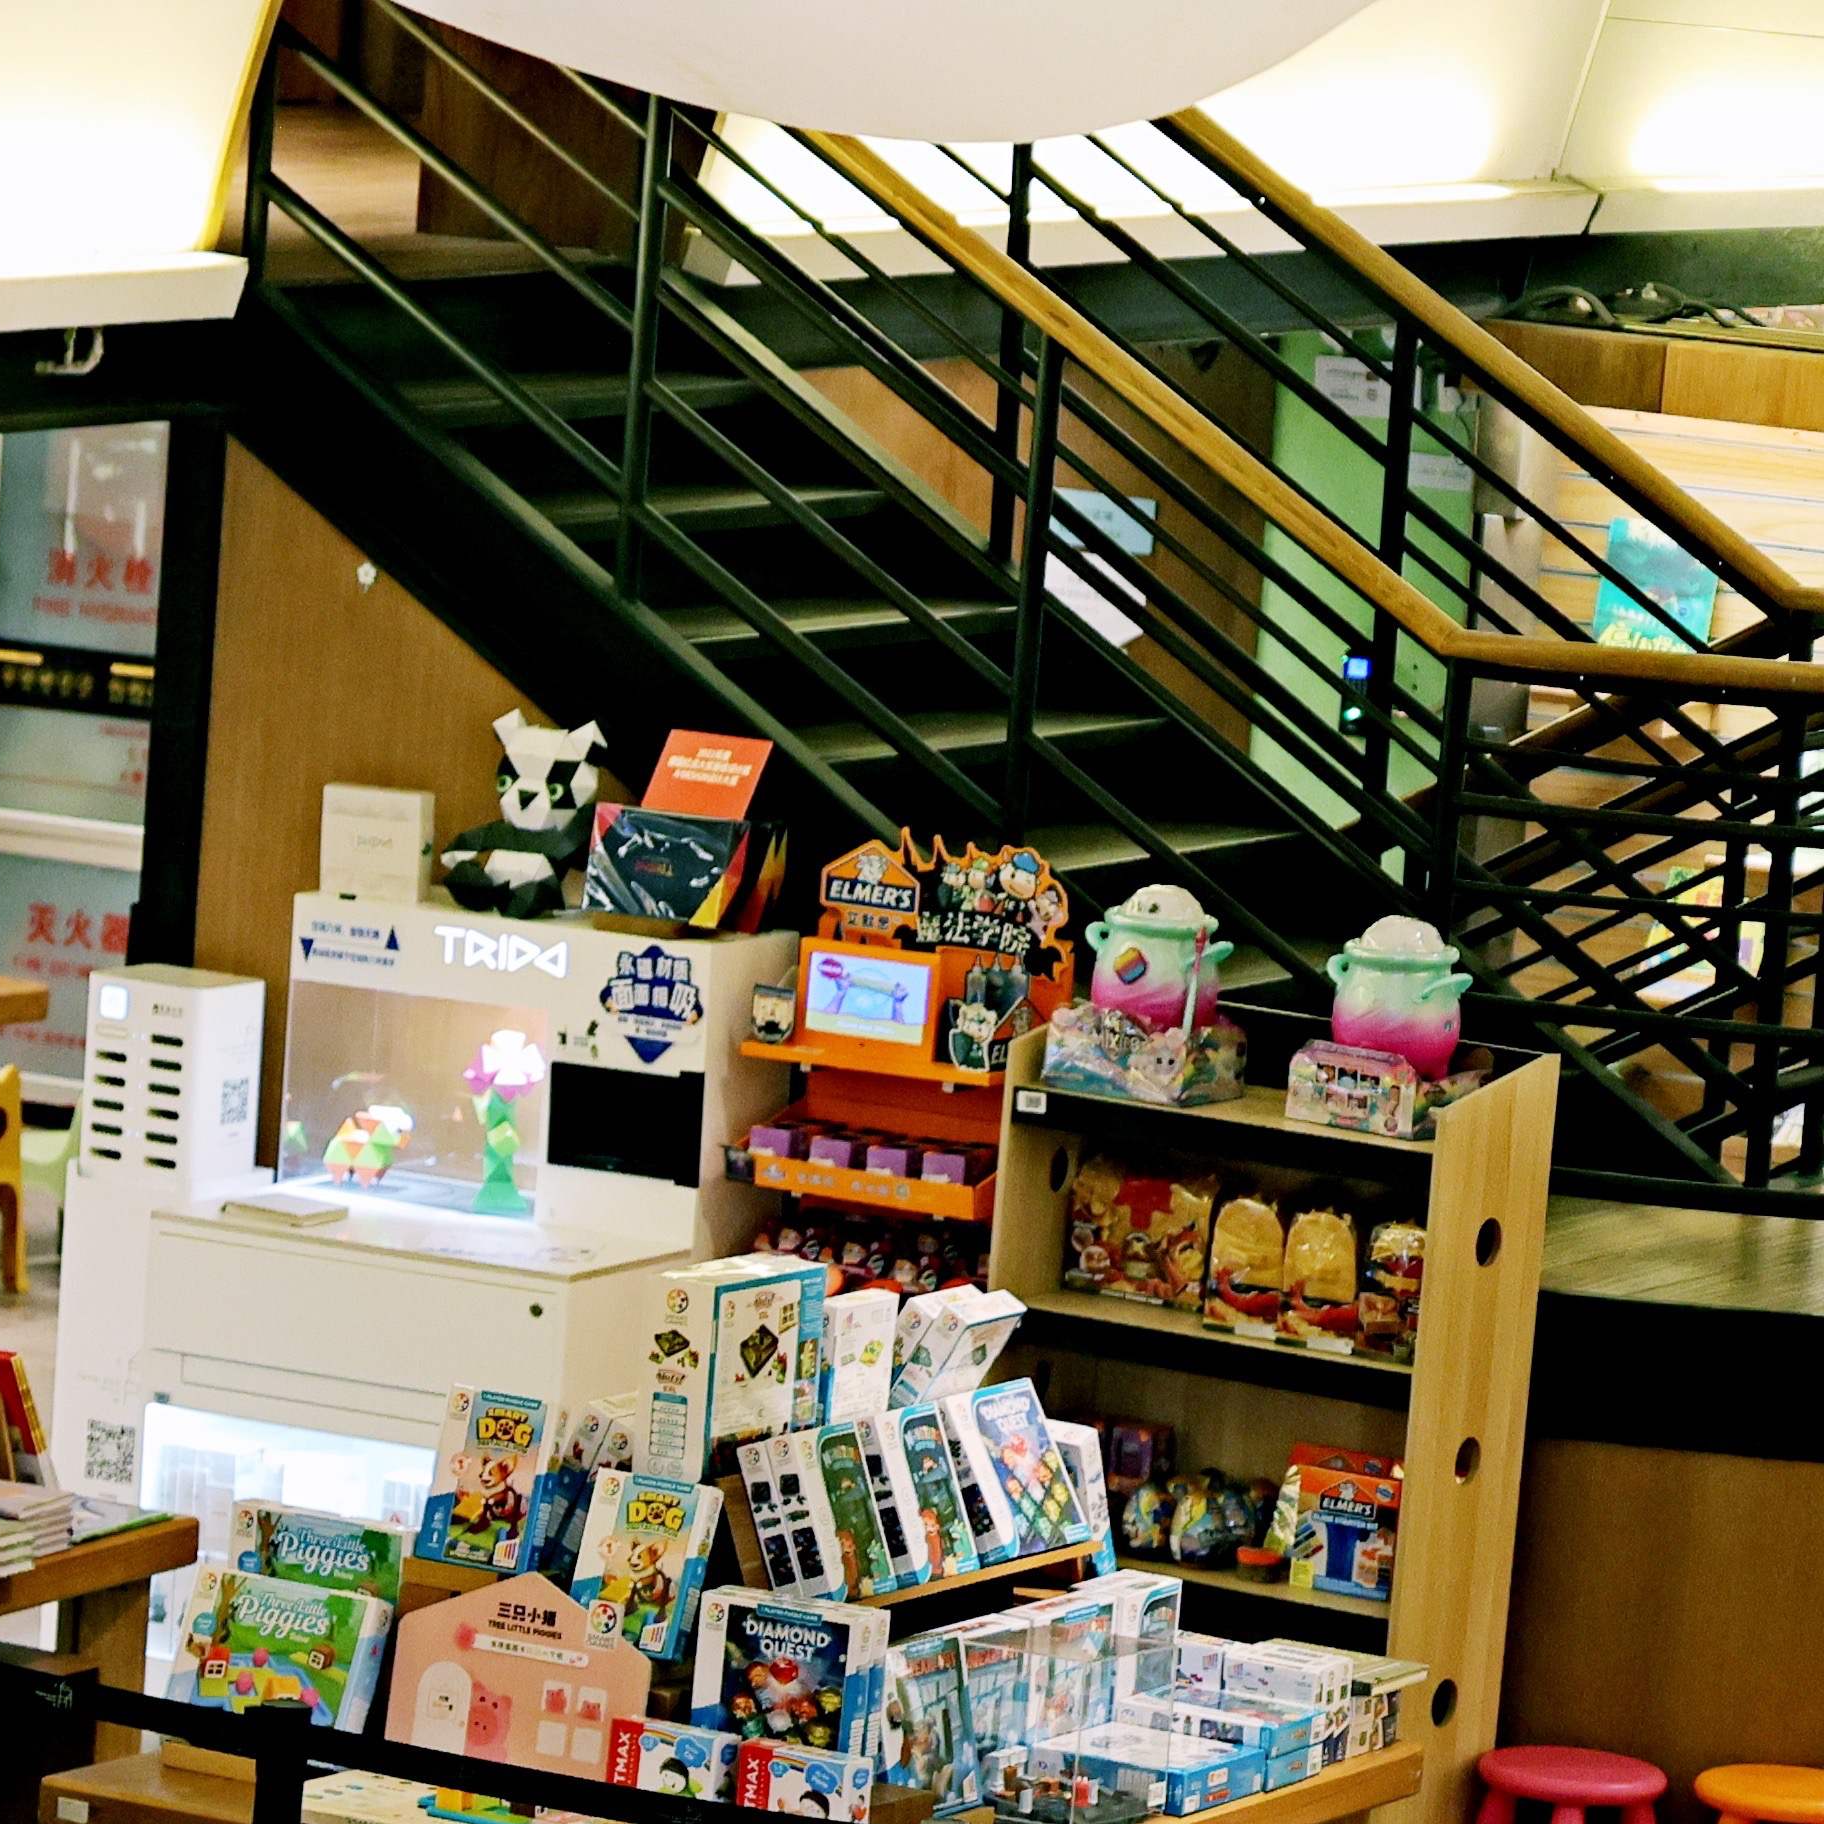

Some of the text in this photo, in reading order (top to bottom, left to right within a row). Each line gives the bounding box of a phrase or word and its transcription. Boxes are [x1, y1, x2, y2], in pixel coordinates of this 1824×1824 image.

[829, 879, 913, 909] ELMER'S
[476, 1415, 535, 1448] DOG
[626, 1500, 686, 1533] DOG
[278, 1530, 376, 1577] Piggies
[236, 1594, 332, 1638] Piggies
[497, 1601, 557, 1628] 三只小猪
[745, 1617, 832, 1648] DIAMOND
[760, 1639, 818, 1660] QUEST
